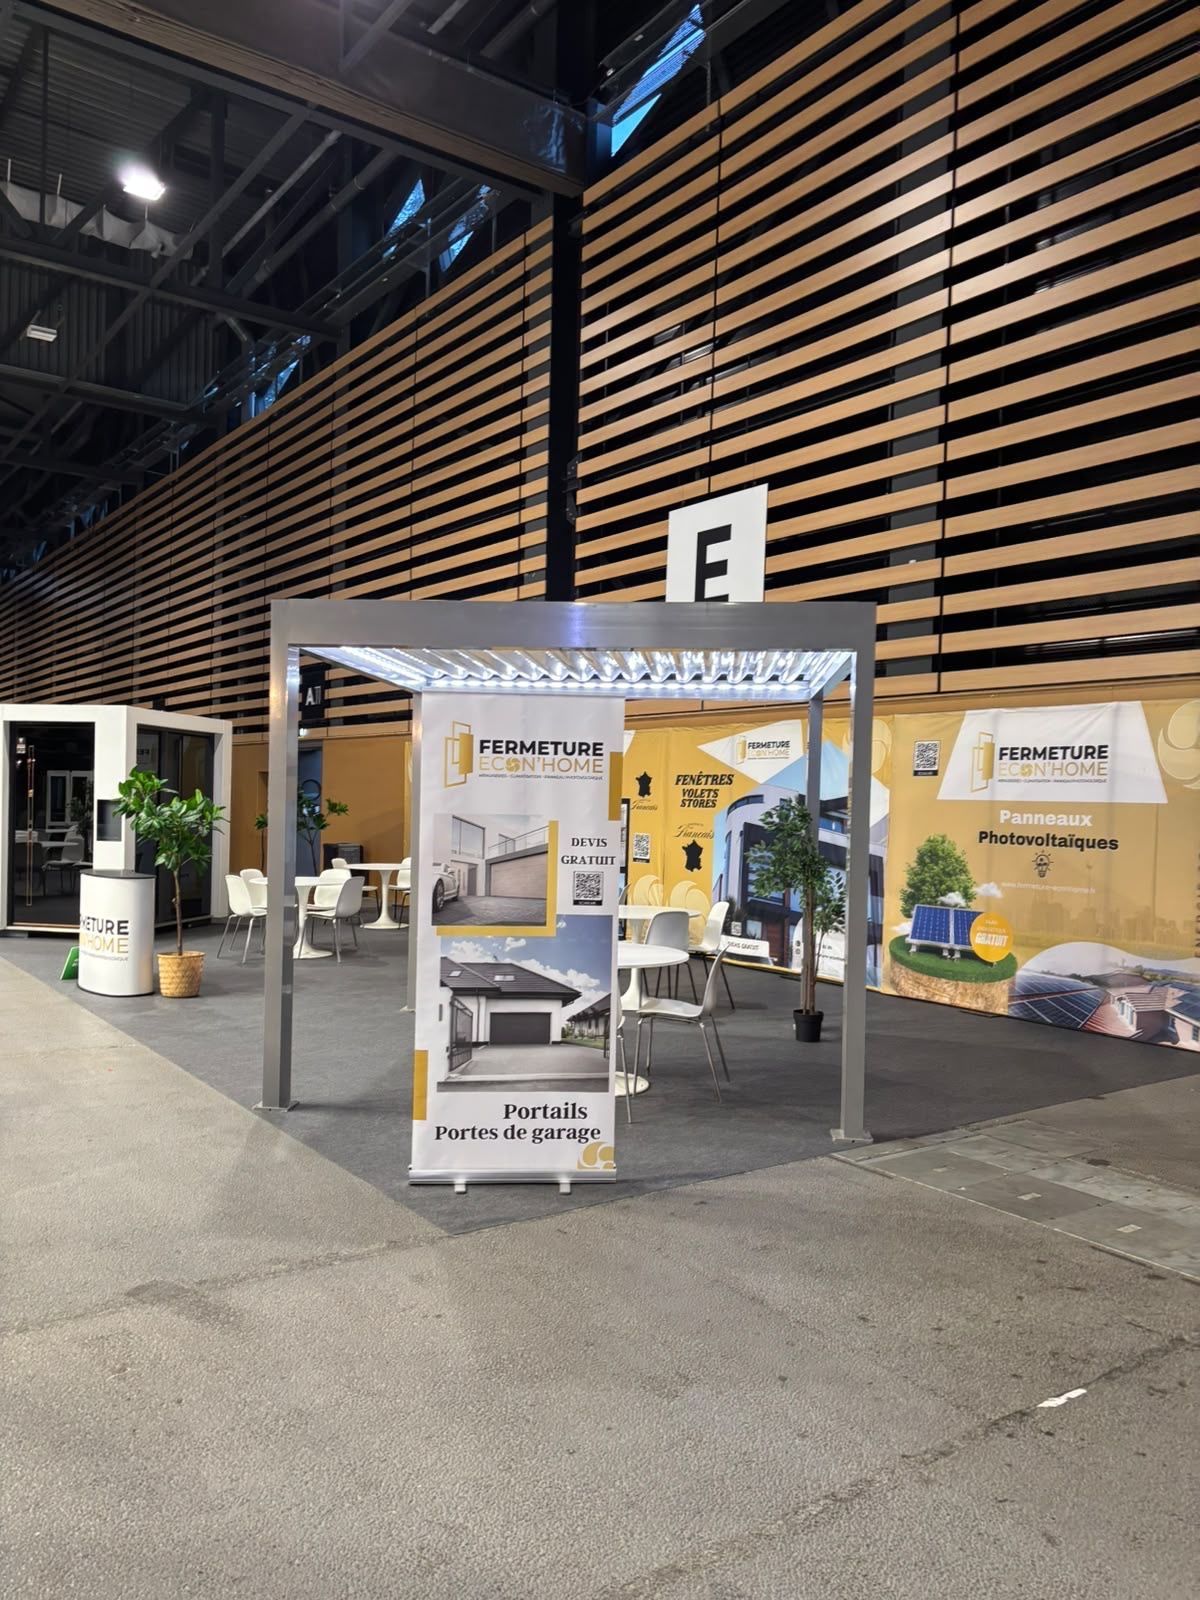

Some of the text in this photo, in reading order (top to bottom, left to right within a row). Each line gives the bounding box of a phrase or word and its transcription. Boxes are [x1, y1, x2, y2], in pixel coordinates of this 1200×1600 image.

[694, 523, 732, 602] E
[479, 739, 604, 756] FERMETURE
[747, 740, 791, 749] FERMETURE
[998, 745, 1109, 760] FERMETURE
[682, 788, 719, 799] VOLETS
[680, 799, 717, 808] STORES
[999, 809, 1092, 827] Panneaux
[571, 837, 608, 847] DEVIS
[978, 831, 1119, 852] Photovoltaïques
[561, 855, 616, 865] GRATUIT
[503, 1102, 588, 1119] Portails
[435, 1124, 601, 1144] Portes de garage
